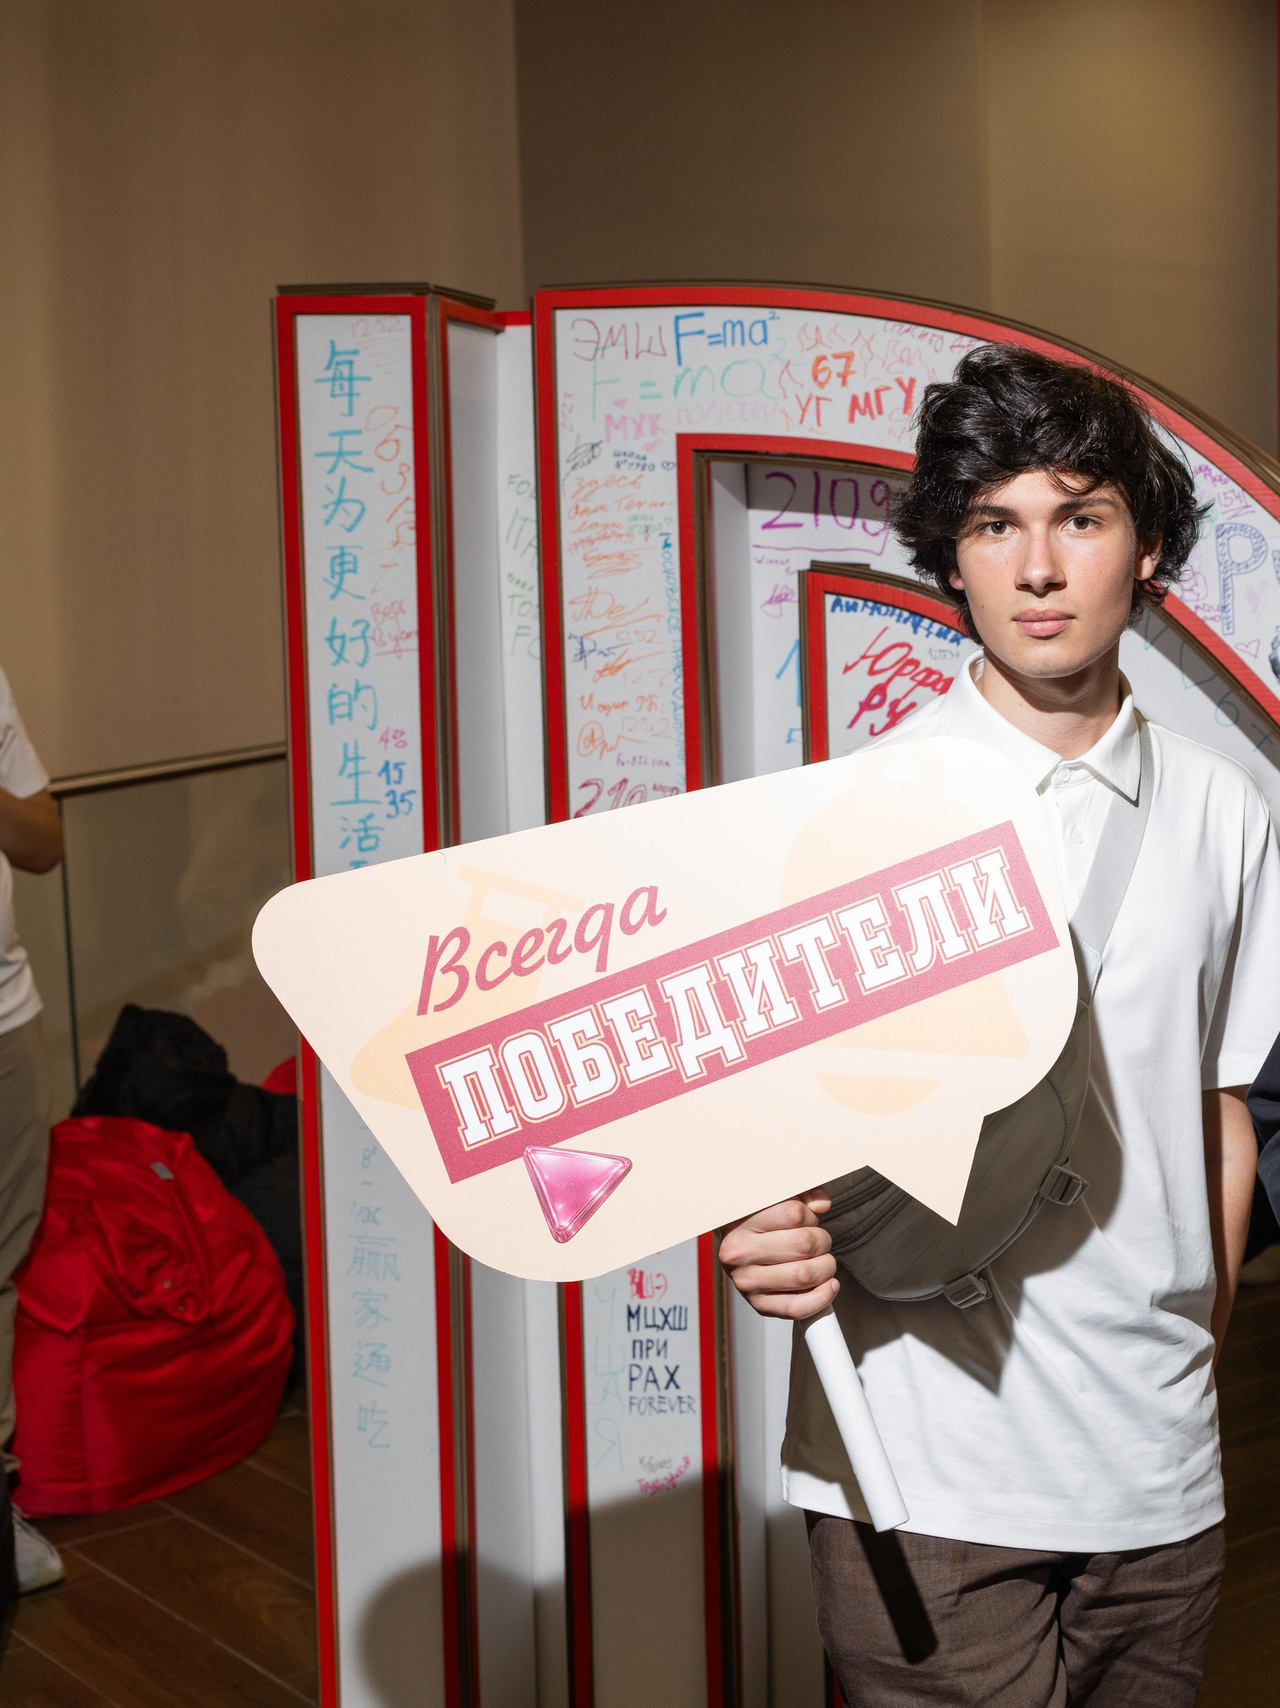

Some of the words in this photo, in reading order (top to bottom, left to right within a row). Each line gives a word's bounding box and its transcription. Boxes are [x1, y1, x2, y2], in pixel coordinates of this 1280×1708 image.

[571, 317, 667, 362] ЭМШ
[811, 349, 858, 390] 67
[847, 375, 918, 425] МГУ
[313, 338, 385, 868] 每天为更好的生活
[376, 761, 406, 788] 15
[384, 789, 417, 820] 35
[415, 885, 668, 1017] Всегда
[435, 845, 1037, 1151] ПОБЕДИТЕЛИ
[626, 1303, 689, 1333] МЦХШ
[631, 1338, 669, 1361] ПРИ
[628, 1362, 681, 1393] РАХ
[628, 1394, 698, 1417] FOREVER
